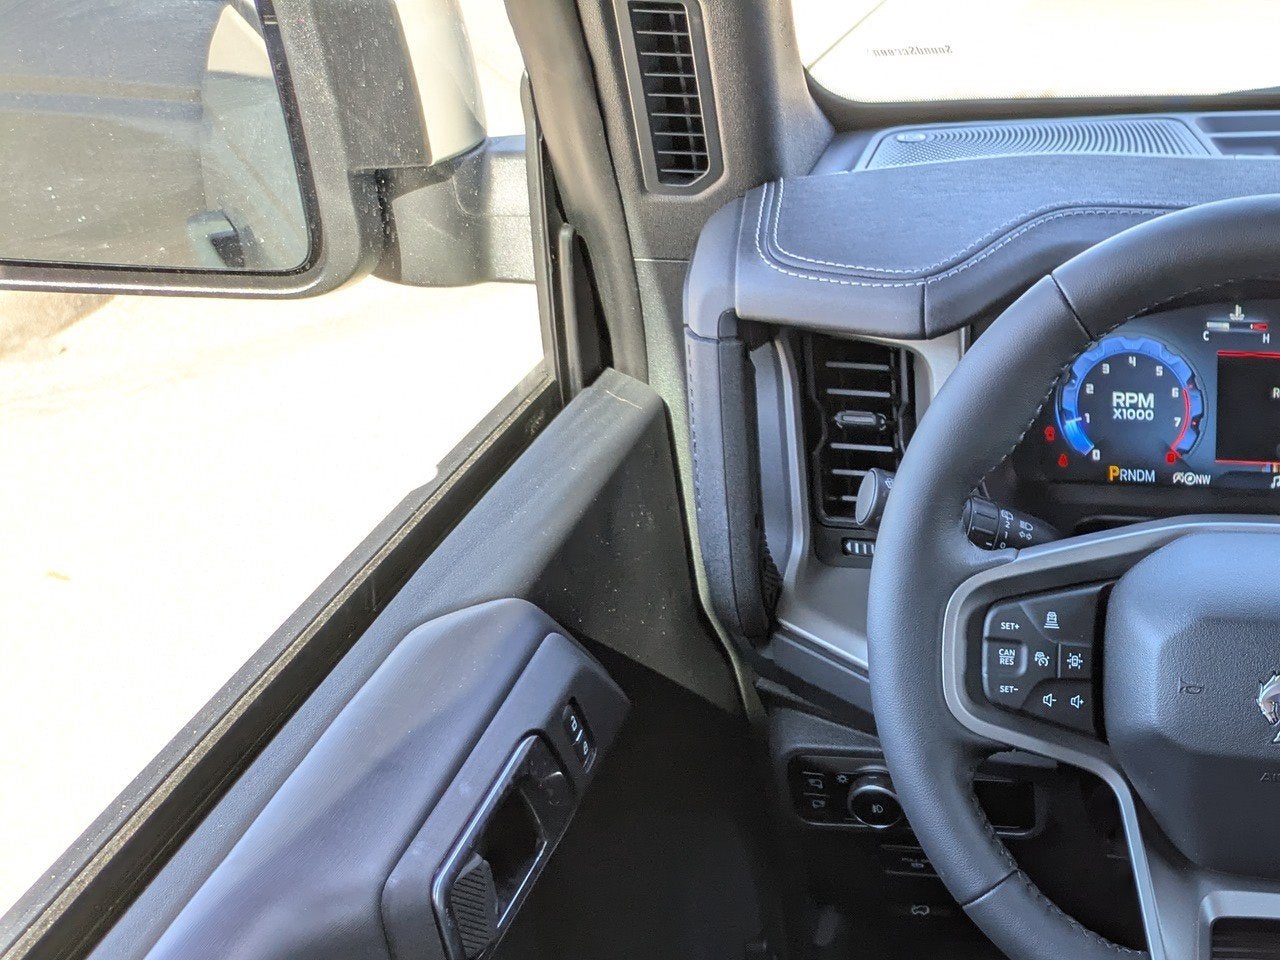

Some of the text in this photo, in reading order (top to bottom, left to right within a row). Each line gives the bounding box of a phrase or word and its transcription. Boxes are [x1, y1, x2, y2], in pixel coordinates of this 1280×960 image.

[1203, 330, 1210, 341] C
[1262, 333, 1270, 344] H
[1128, 356, 1137, 367] 4
[1102, 363, 1110, 374] 3
[1155, 366, 1164, 376] 5
[1085, 383, 1094, 394] 2
[1171, 387, 1179, 398] 6
[1112, 391, 1155, 409] RPM
[1085, 412, 1091, 423] 1
[1112, 409, 1155, 421] X1000
[1173, 416, 1181, 427] 7
[1092, 450, 1101, 461] 0
[1195, 474, 1211, 485] NW
[1000, 622, 1020, 630] SET+
[998, 648, 1016, 656] CAN
[999, 657, 1015, 666] RES
